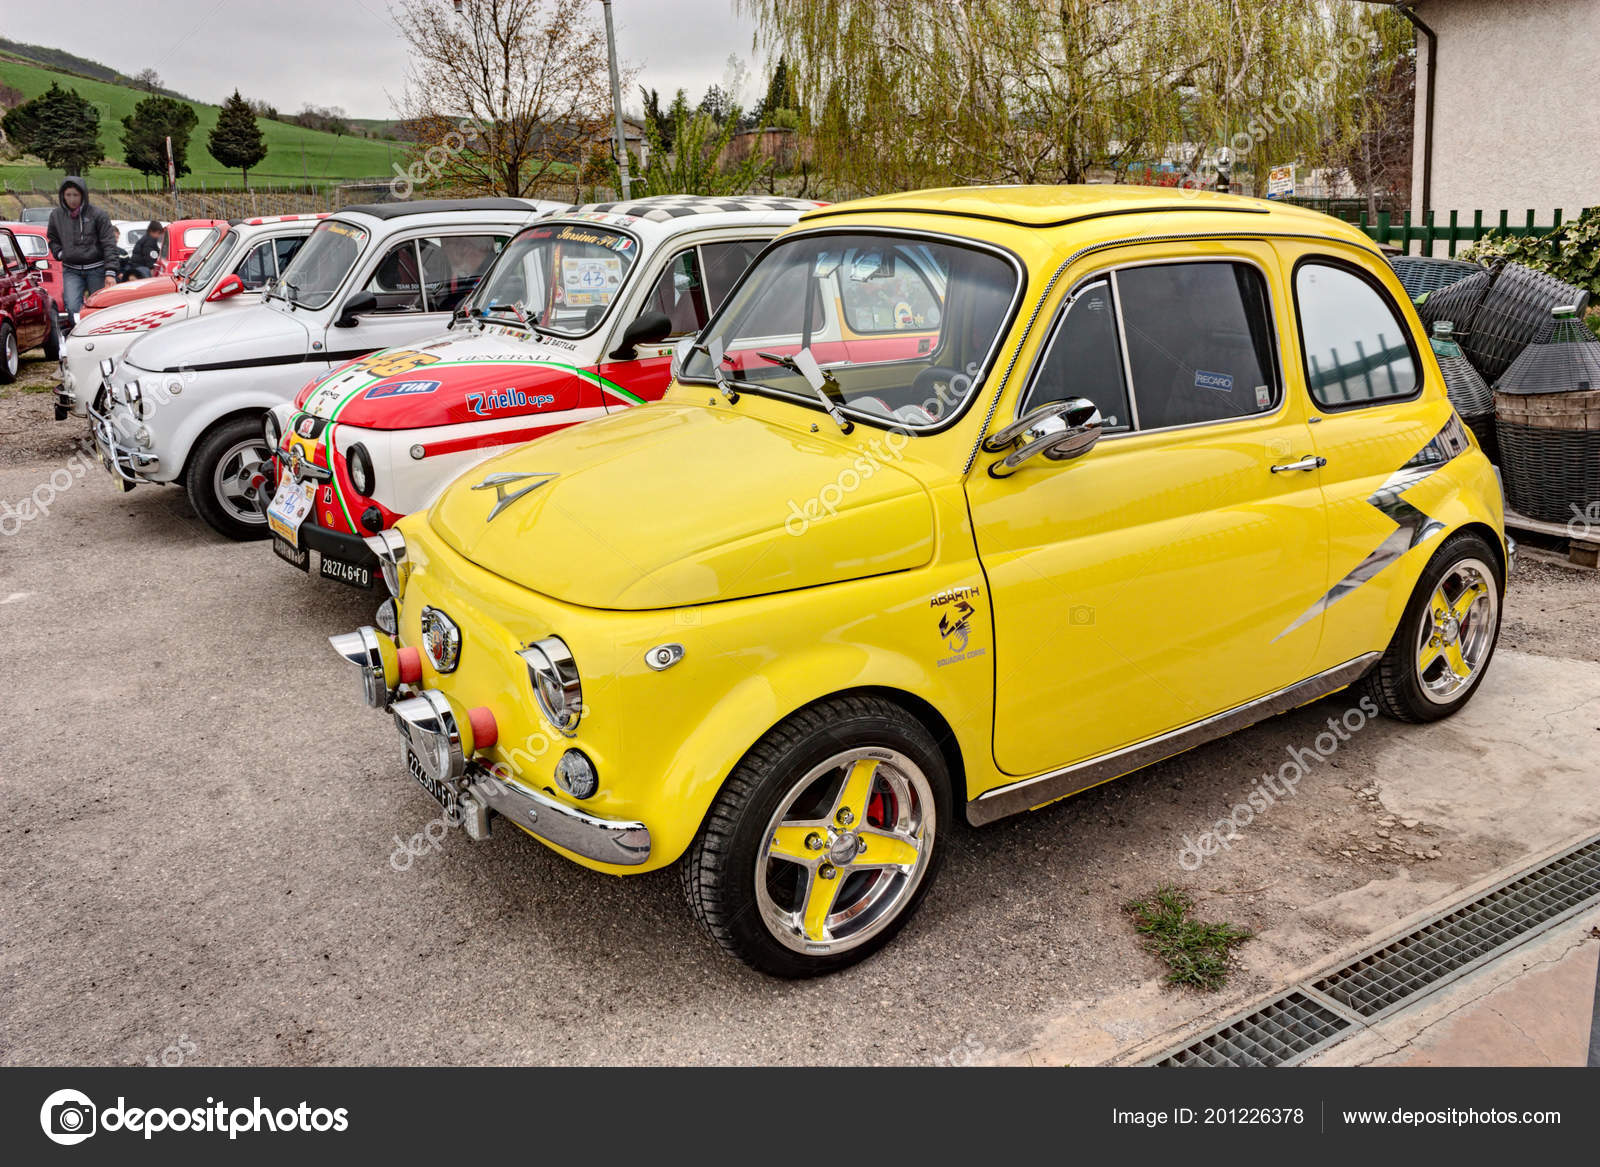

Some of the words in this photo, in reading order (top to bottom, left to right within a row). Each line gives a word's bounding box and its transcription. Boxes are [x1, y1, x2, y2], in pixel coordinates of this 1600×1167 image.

[583, 271, 604, 287] 43
[353, 350, 441, 379] 46
[396, 382, 432, 393] TIM
[1196, 374, 1232, 388] RECARO
[487, 387, 527, 409] riello
[528, 393, 554, 408] ups
[930, 586, 980, 608] ABARTH
